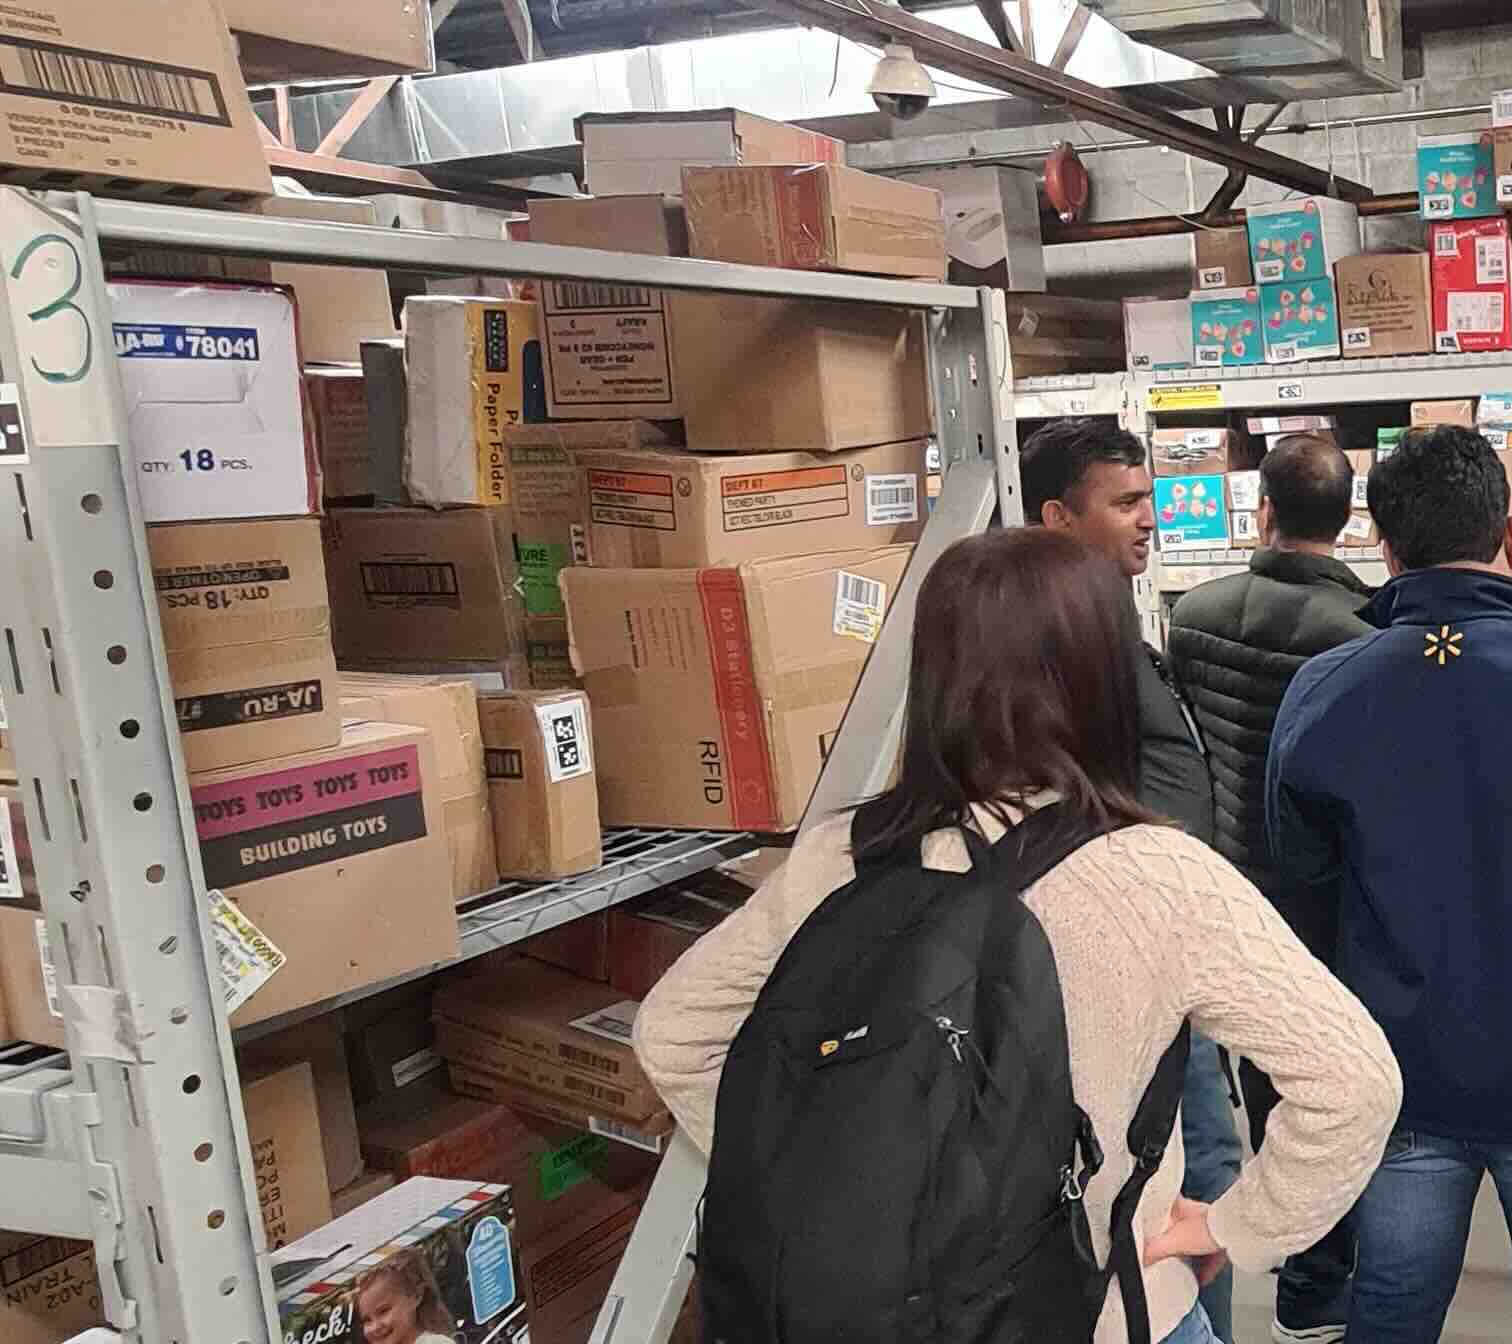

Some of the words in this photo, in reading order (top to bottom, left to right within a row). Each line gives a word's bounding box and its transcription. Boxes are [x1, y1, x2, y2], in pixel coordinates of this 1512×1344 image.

[11, 234, 92, 384] 3
[185, 335, 257, 359] 78041
[483, 383, 501, 437] Paper
[179, 449, 215, 471] 18
[221, 459, 252, 470] PCS.
[489, 441, 505, 500] Folder
[204, 590, 232, 610] 18
[244, 685, 318, 716] JA-RU
[255, 783, 304, 811] TOYS
[314, 772, 359, 798] TOYS
[367, 761, 409, 785] TOYS
[699, 740, 723, 805] RFID
[240, 827, 337, 866] BUILDING
[341, 815, 387, 840] TOYS
